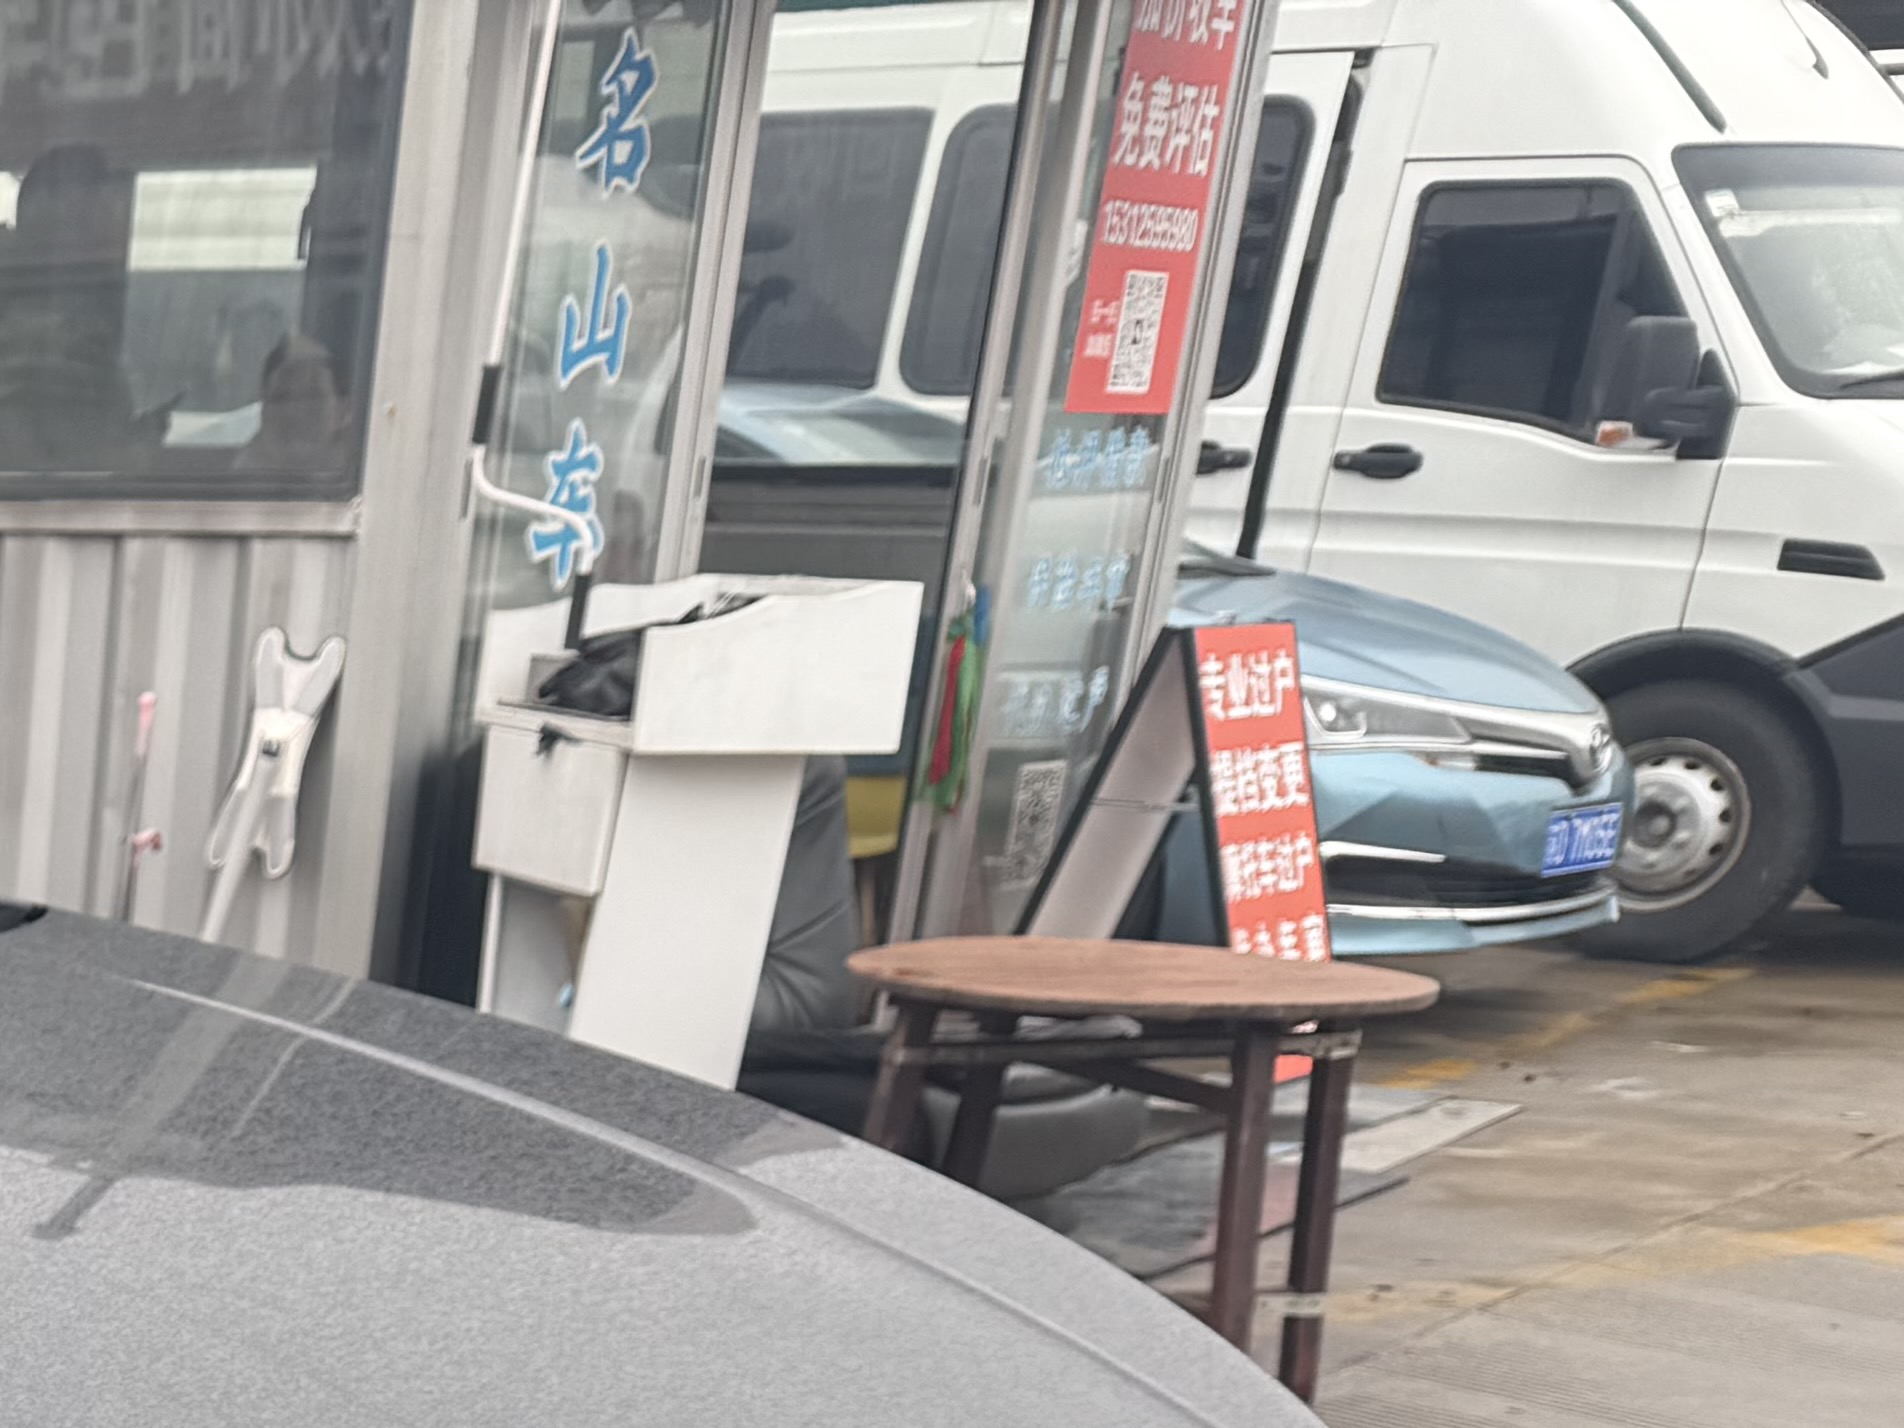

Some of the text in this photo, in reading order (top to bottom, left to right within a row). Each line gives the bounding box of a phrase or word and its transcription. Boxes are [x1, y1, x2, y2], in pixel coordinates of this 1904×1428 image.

[1112, 72, 1219, 177] 免费评估
[1200, 649, 1294, 720] 专业过户
